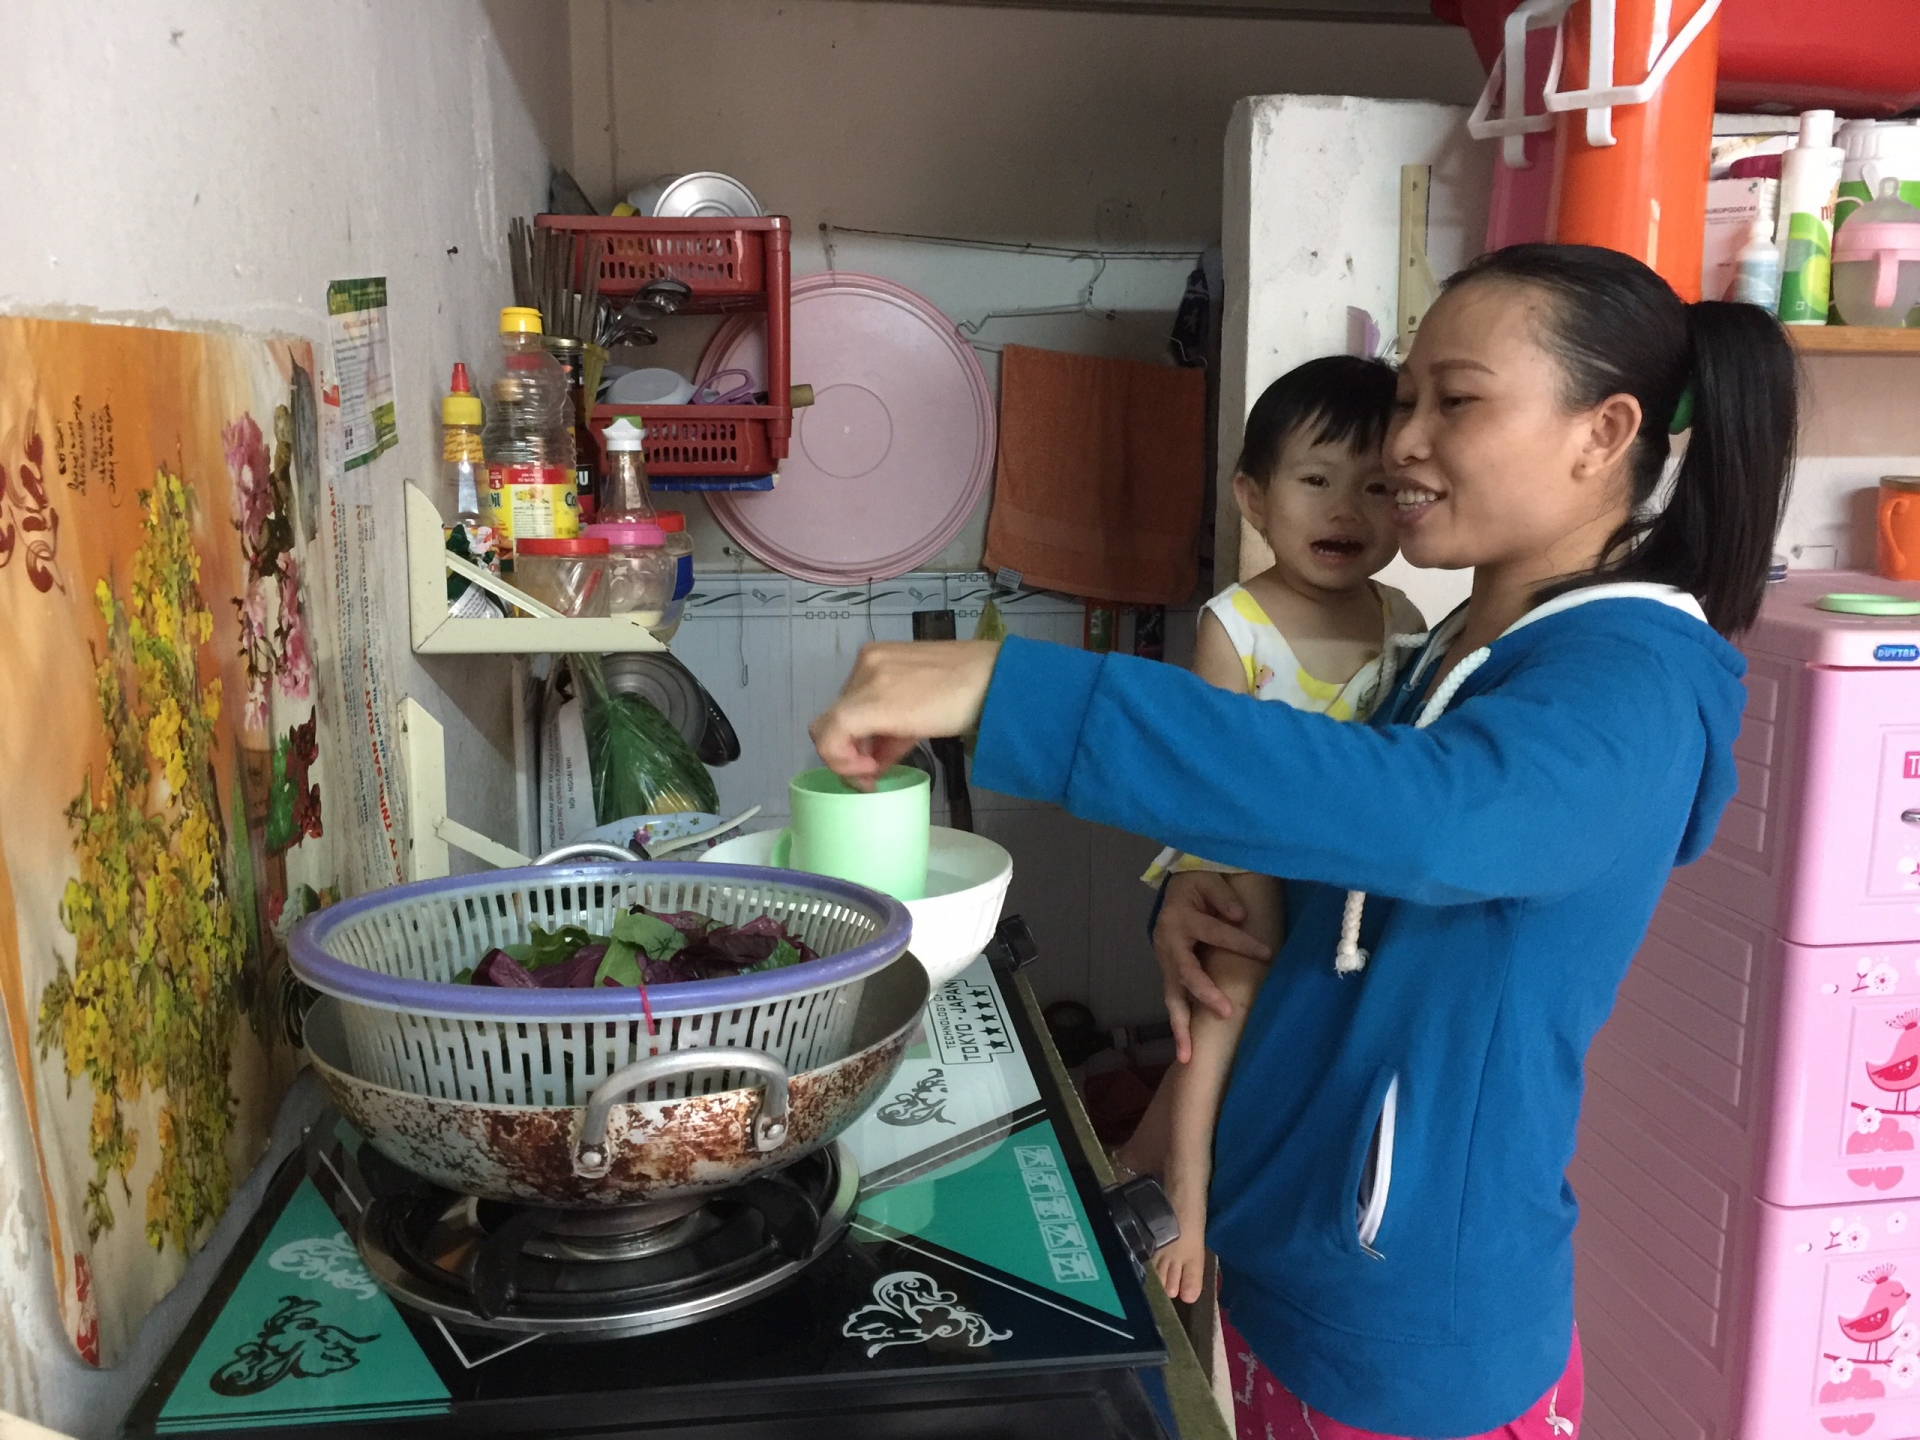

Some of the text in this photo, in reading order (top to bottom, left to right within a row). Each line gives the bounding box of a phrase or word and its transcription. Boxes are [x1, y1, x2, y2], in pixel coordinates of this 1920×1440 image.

[379, 782, 393, 832] TNHH
[936, 1004, 956, 1049] TECHNOLOGY
[944, 981, 981, 1061] TOKYO JAPAN
